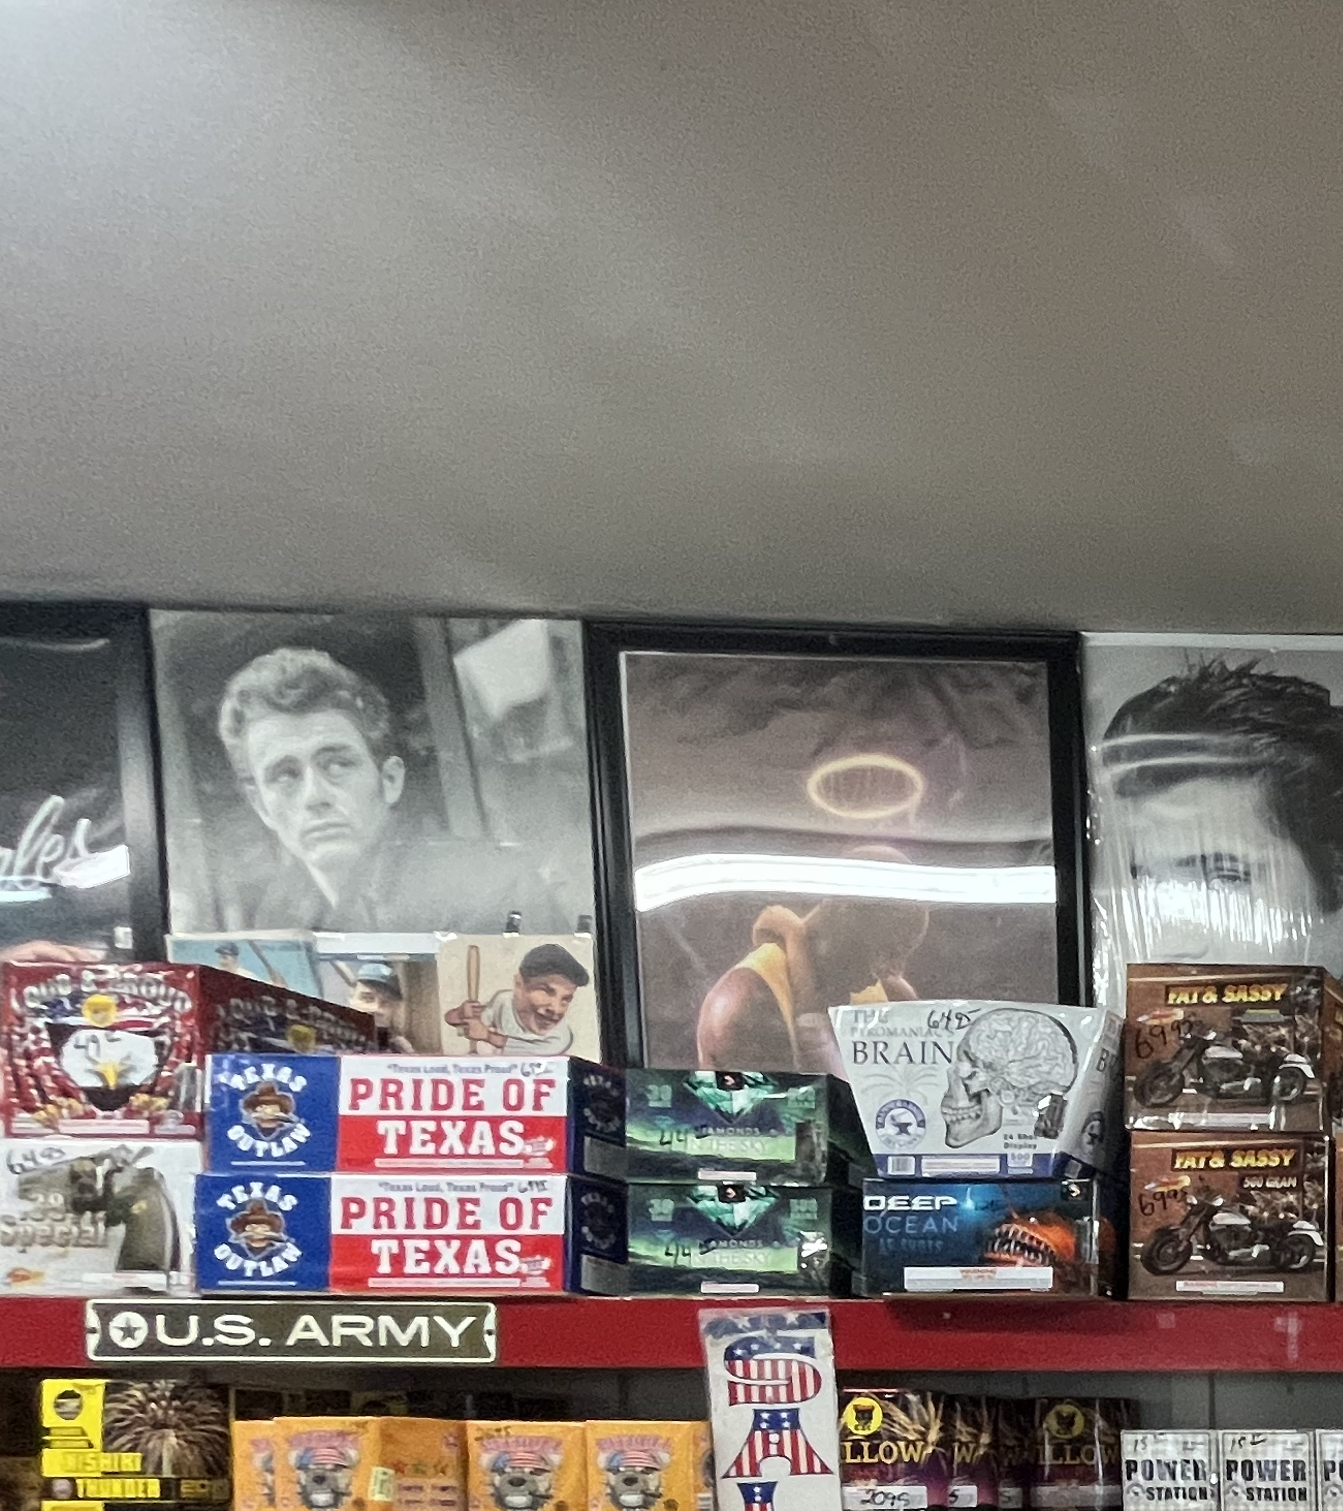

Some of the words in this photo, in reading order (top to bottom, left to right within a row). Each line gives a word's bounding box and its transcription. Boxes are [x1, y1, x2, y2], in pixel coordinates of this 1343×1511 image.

[852, 1041, 954, 1065] BRAIN
[349, 1078, 485, 1111] PRIDE
[501, 1077, 556, 1111] OF
[378, 1119, 524, 1155] TEXAS
[1230, 1149, 1297, 1168] SASSY
[216, 1181, 298, 1211] TEXAS
[863, 1196, 958, 1211] DEEP
[341, 1196, 478, 1230] PRIDE
[500, 1196, 554, 1230] OF
[863, 1215, 960, 1234] OCEAN
[213, 1242, 303, 1277] OUTLAW
[371, 1239, 522, 1275] TEXAS
[156, 1315, 270, 1347] U.S.
[286, 1315, 476, 1348] ARMY
[1226, 1459, 1306, 1482] POWER
[1246, 1486, 1306, 1501] STATION
